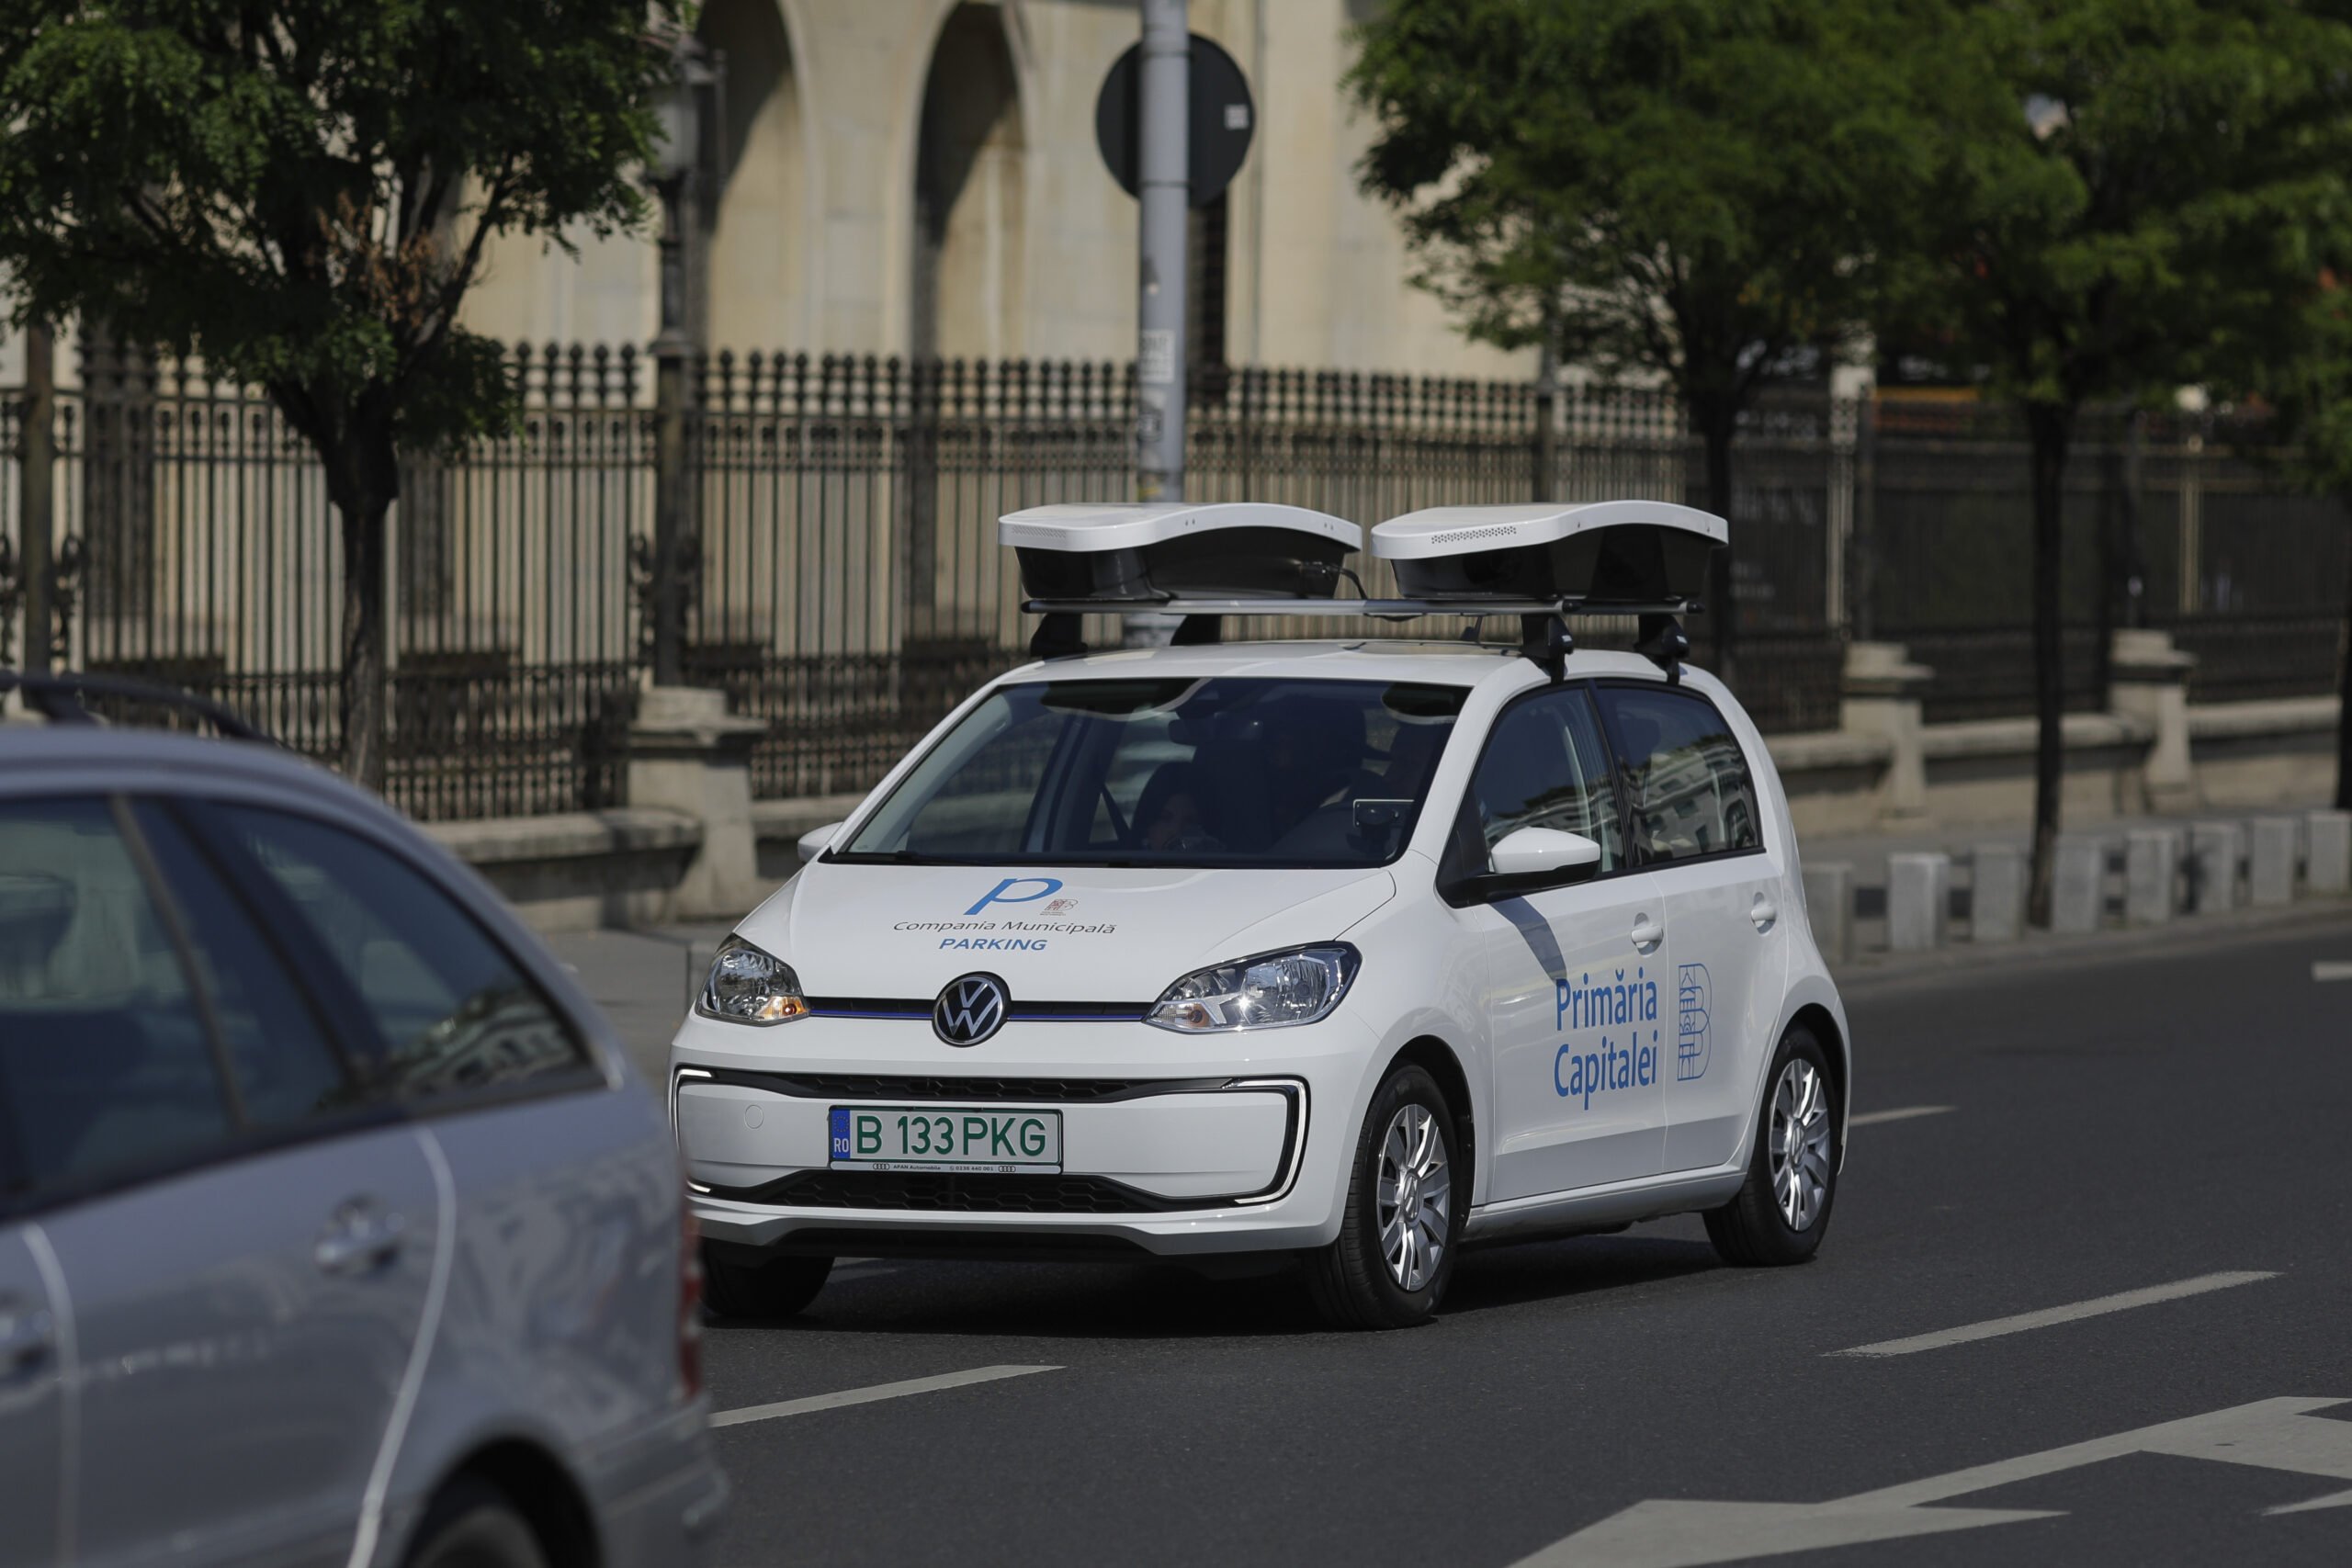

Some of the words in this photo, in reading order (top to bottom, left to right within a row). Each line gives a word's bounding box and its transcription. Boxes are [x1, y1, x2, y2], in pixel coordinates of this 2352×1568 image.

[893, 921, 995, 933] Compania
[1001, 921, 1118, 935] Municipală
[938, 938, 1048, 952] PARKING
[1555, 966, 1657, 1032] Primăria
[1554, 1029, 1658, 1111] Capitalei
[833, 1137, 850, 1153] RO
[856, 1115, 882, 1154] B
[897, 1115, 955, 1156] 133
[963, 1117, 1046, 1156] PKG
